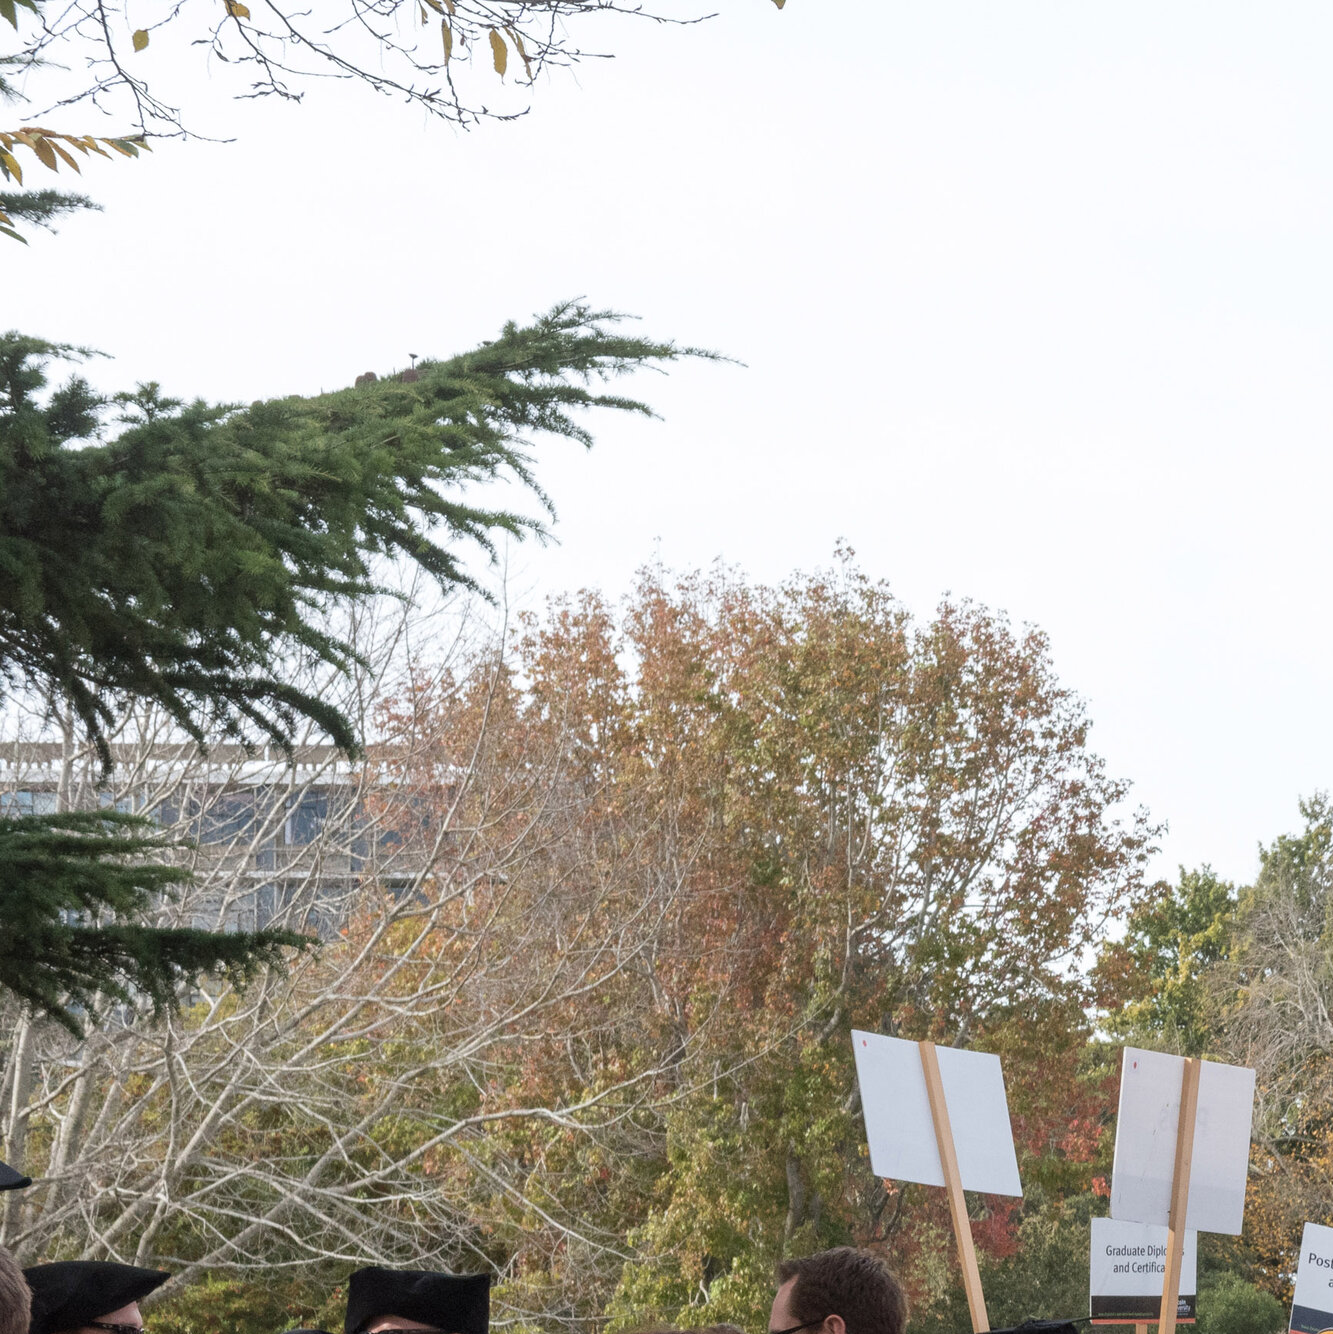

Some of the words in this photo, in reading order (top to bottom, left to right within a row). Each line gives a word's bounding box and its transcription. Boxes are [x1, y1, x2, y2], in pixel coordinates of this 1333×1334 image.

[1105, 1245, 1146, 1257] Graduate
[1113, 1262, 1130, 1273] and
[1131, 1262, 1166, 1273] Certifica
